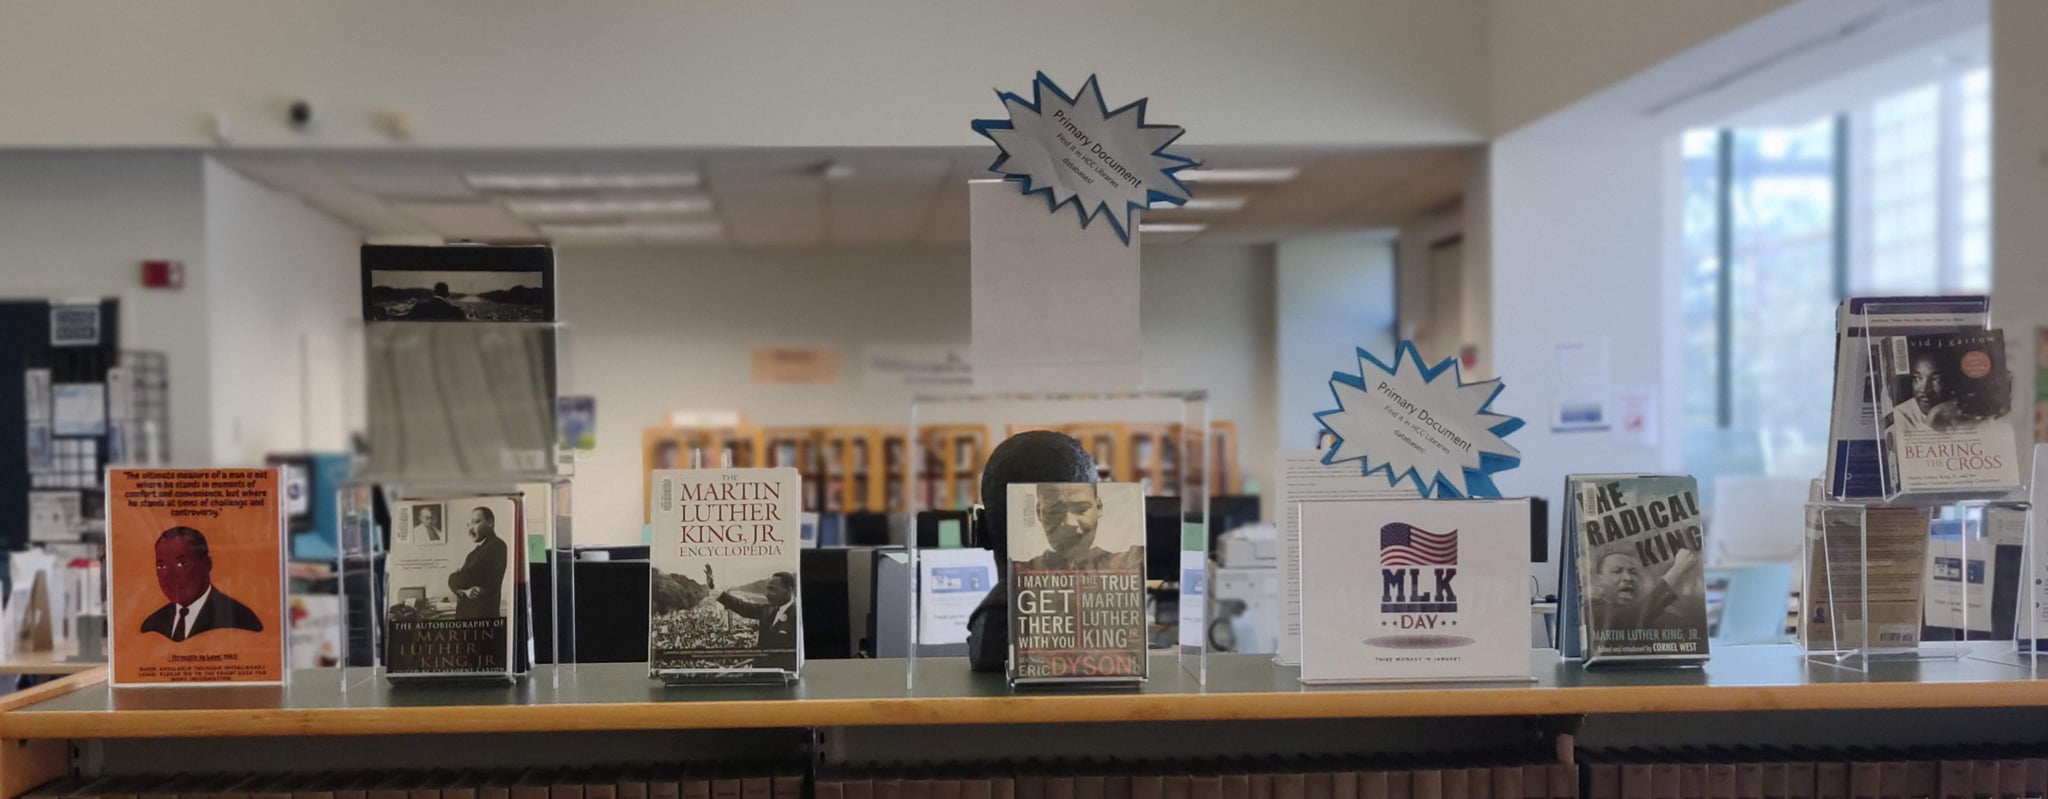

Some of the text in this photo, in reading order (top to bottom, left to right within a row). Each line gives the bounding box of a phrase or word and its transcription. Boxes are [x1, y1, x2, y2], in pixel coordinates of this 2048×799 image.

[1053, 109, 1142, 188] Primary Document
[1910, 338, 1931, 348] vid
[1377, 381, 1472, 453] Primary Document
[1905, 442, 1984, 459] BEARING
[1946, 455, 2002, 471] CROSS
[211, 470, 221, 479] of
[254, 471, 268, 479] not
[722, 473, 738, 481] THE
[164, 481, 174, 489] he
[175, 481, 200, 489] stands
[247, 480, 256, 488] of
[680, 481, 781, 502] MARTIN
[124, 490, 157, 498] comfort
[200, 499, 209, 507] of
[210, 499, 248, 509] challenge
[680, 502, 783, 523] LUTHER
[1586, 491, 1699, 547] RADICAL
[680, 524, 748, 545] KING,
[679, 545, 782, 558] ENCYCLOPEDIA
[1635, 525, 1703, 568] KING
[1017, 575, 1075, 588] I MAY NOT
[1082, 574, 1140, 591] THE TRUE
[1381, 568, 1457, 602] MLK
[1017, 589, 1075, 615] GET
[1082, 592, 1140, 609] MARTIN
[395, 619, 505, 631] THE AUTOBIOGRAPHY OF
[1017, 616, 1076, 635] THERE
[1082, 610, 1140, 627] LUTHER
[1401, 614, 1438, 629] DAY
[416, 629, 495, 643] MARTIN
[1018, 635, 1076, 649] WITH YOU
[1082, 628, 1128, 649] KING
[1592, 629, 1625, 641] MARTIN
[1626, 628, 1659, 641] LUTHER
[400, 643, 479, 656] LUTHER
[1652, 642, 1679, 653] CORNEL
[1679, 641, 1697, 652] WEST
[420, 655, 469, 669] KING
[1018, 665, 1050, 677] ERIC
[1051, 655, 1133, 676] DYSON
